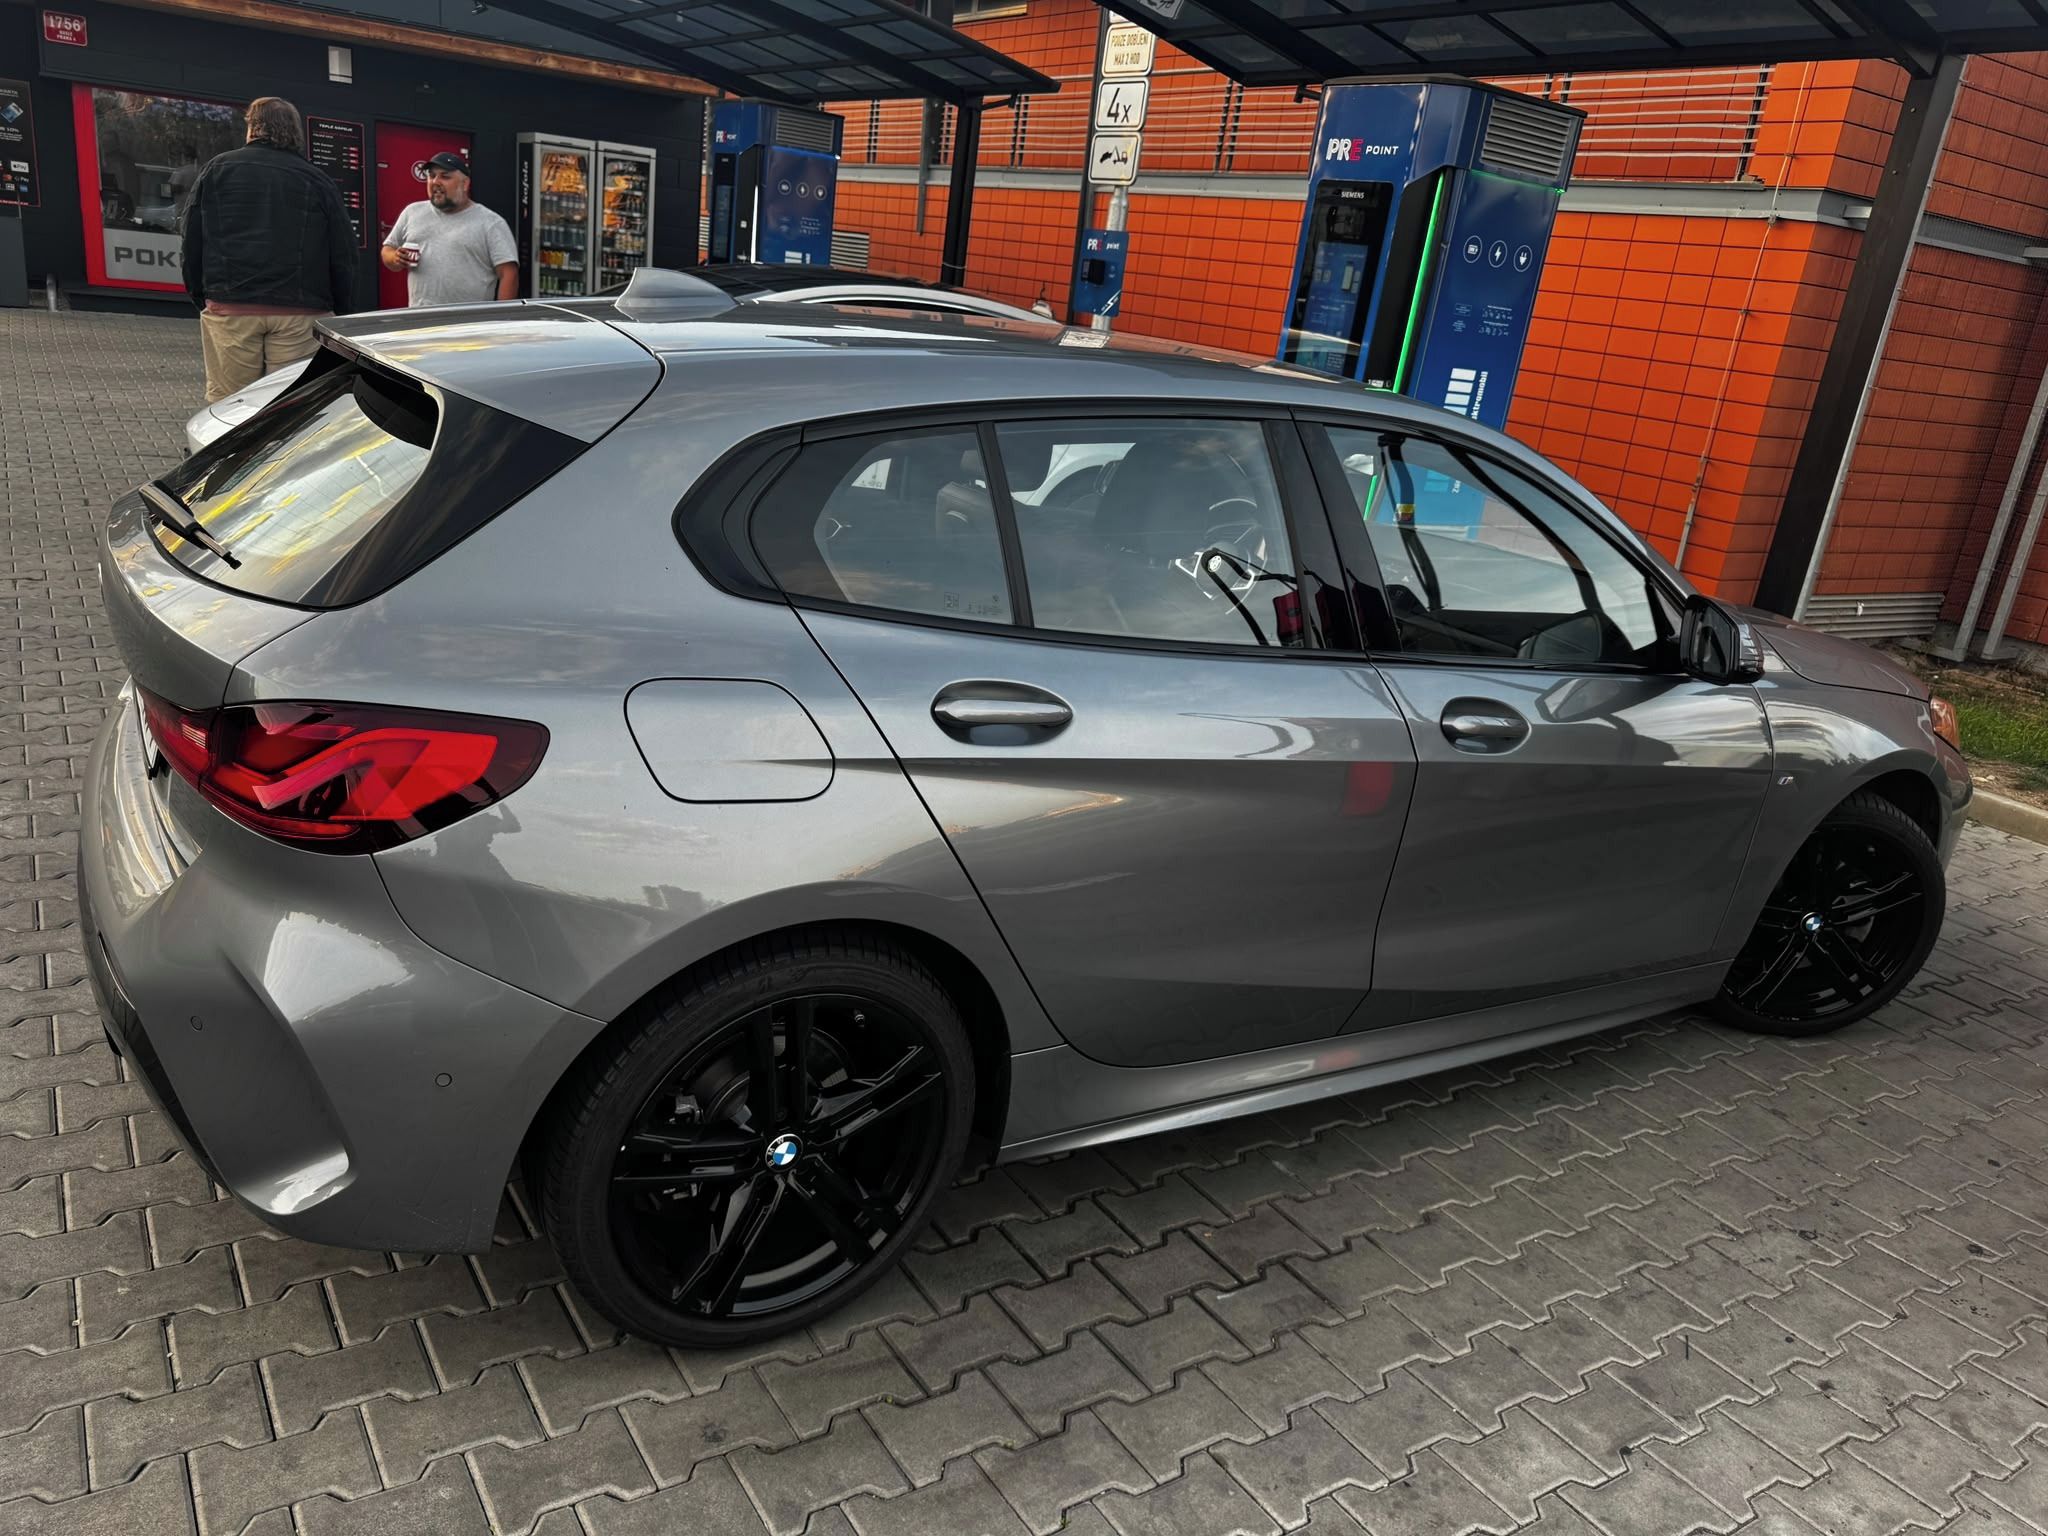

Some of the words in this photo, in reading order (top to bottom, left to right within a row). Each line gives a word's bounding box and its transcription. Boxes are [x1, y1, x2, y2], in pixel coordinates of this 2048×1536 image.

[49, 15, 81, 32] 1756
[1111, 34, 1126, 47] POUZE
[1113, 53, 1125, 65] MAX
[1325, 138, 1364, 161] PRE
[1365, 145, 1399, 155] POINT
[1341, 191, 1365, 199] SIEMENS
[1087, 238, 1103, 252] PRE
